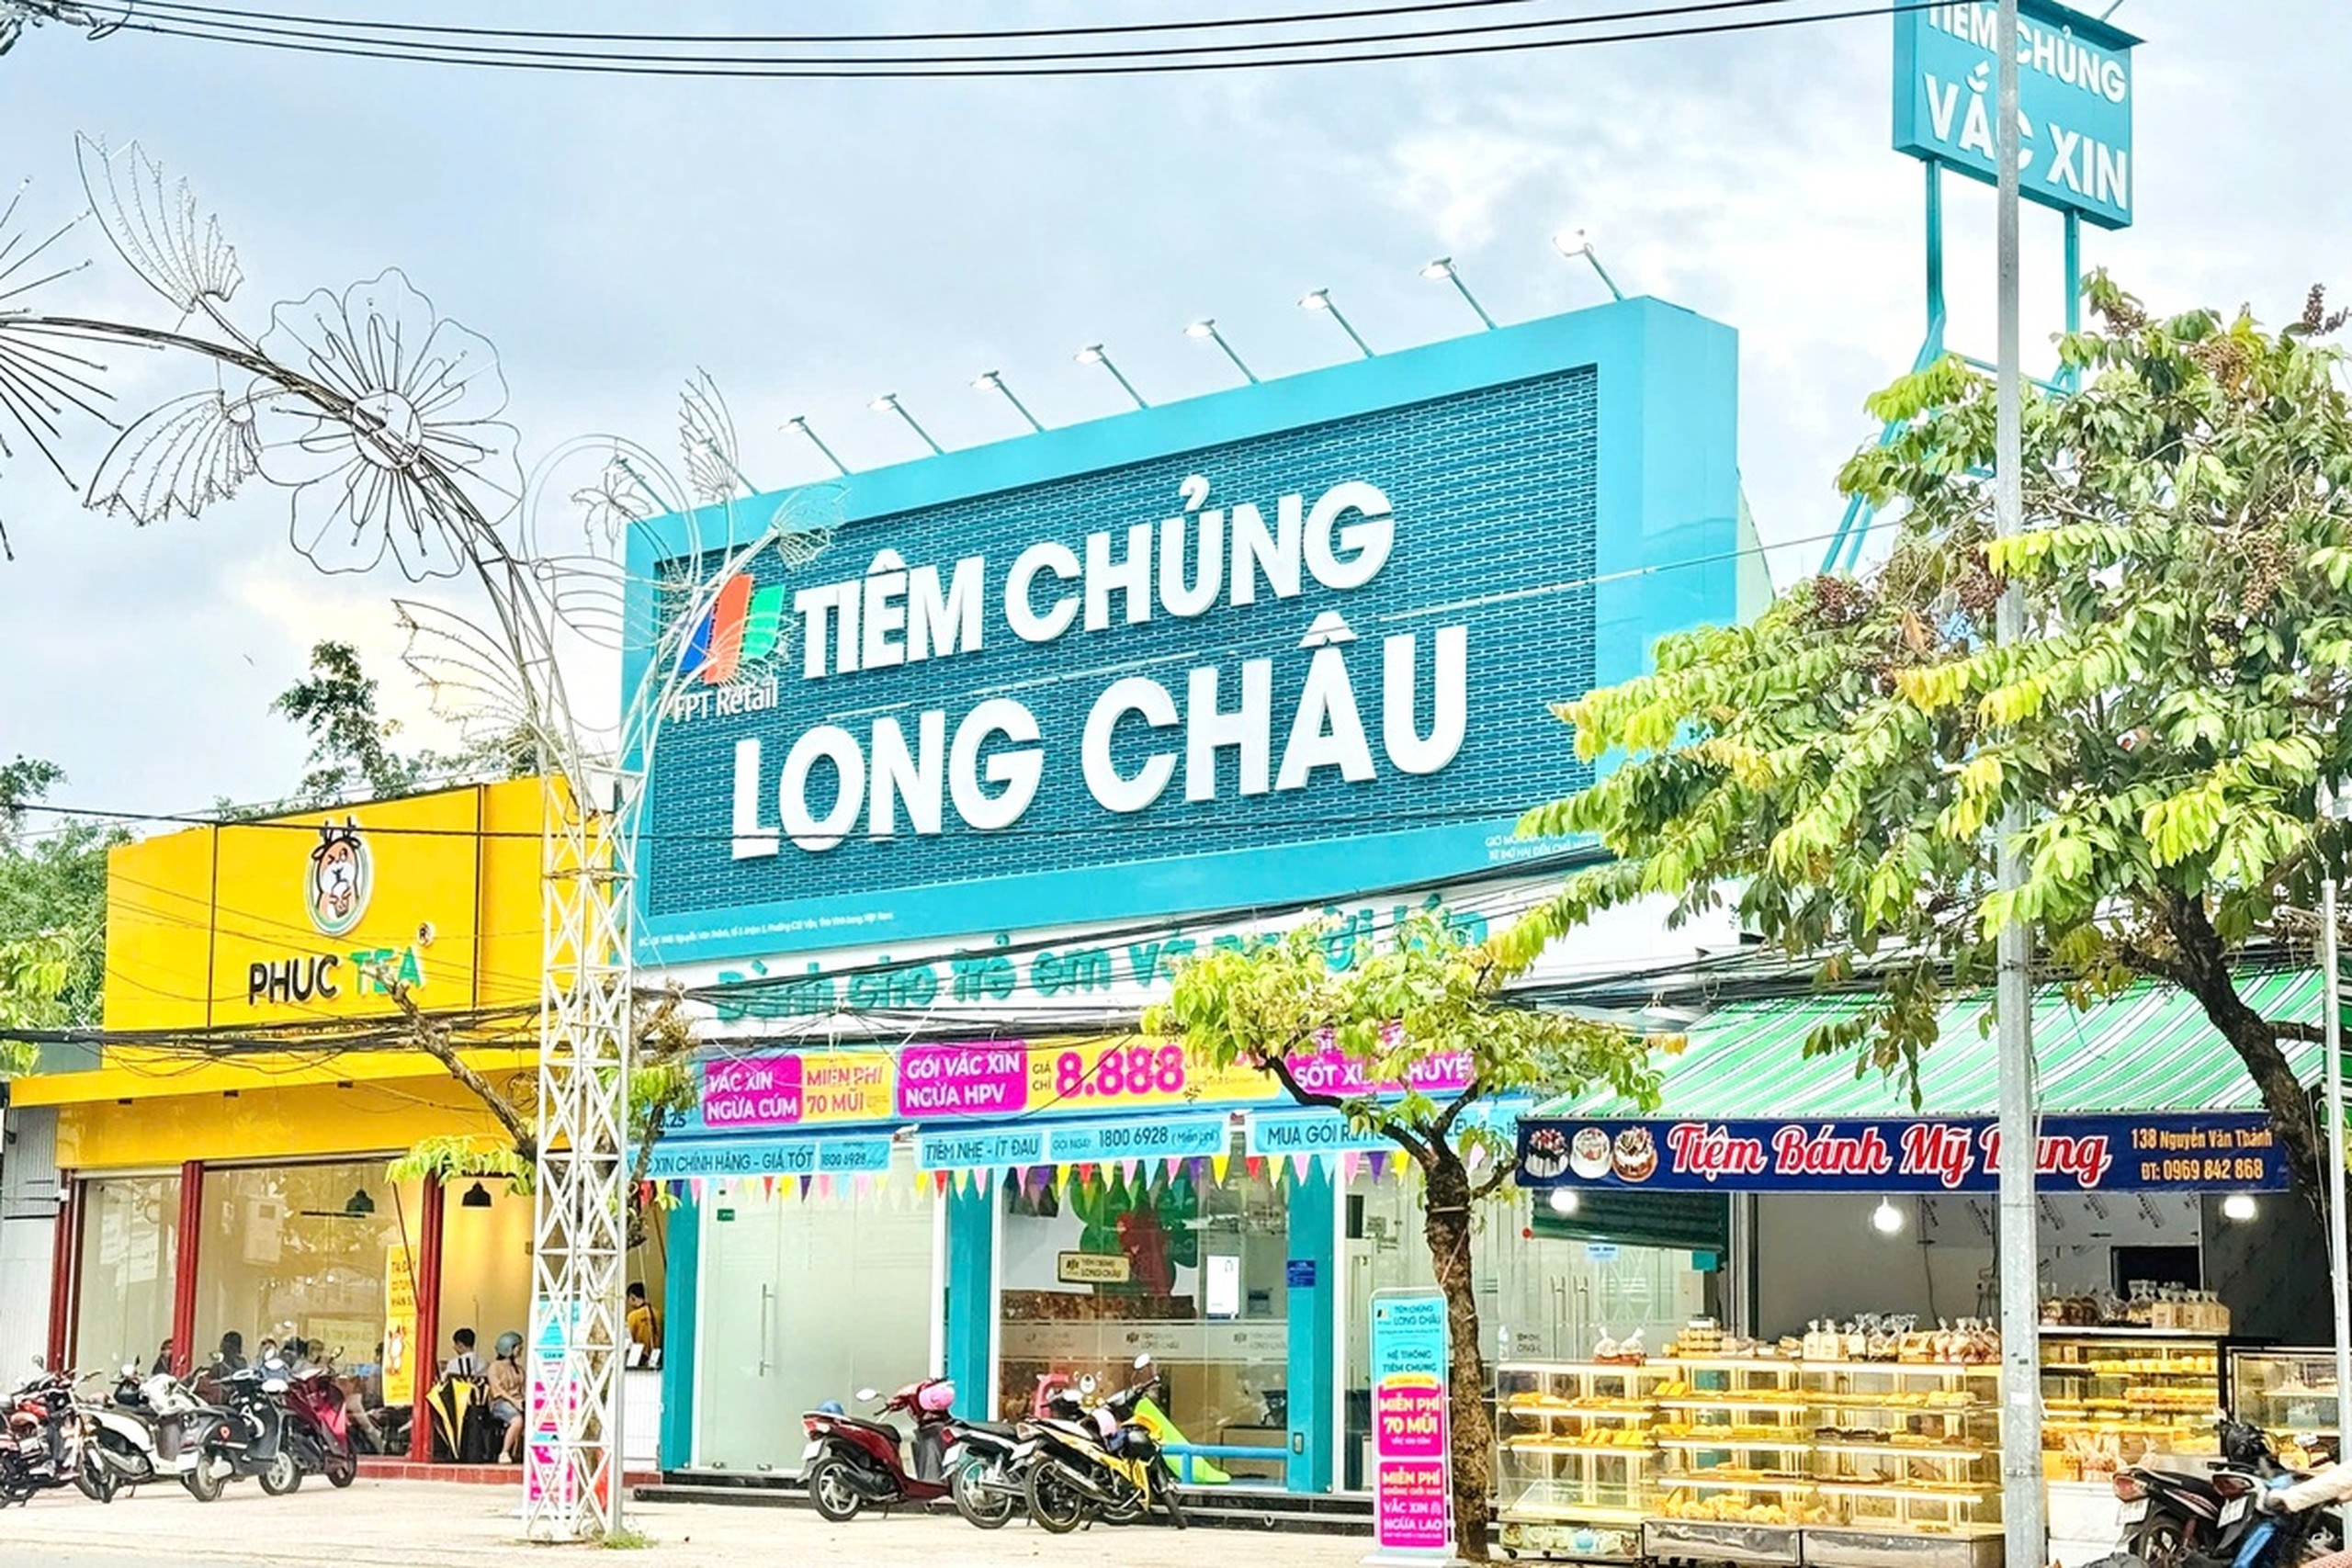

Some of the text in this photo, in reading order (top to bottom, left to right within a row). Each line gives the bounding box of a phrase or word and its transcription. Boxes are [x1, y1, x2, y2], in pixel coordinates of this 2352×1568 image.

[2046, 122, 2127, 210] XIN
[794, 475, 1395, 679] TIÊM CHỦNG
[674, 677, 778, 723] FPT Retail
[733, 611, 1468, 861] LONG CHÂU
[249, 946, 423, 1006] PHUC TEA
[717, 959, 835, 1022] Dành
[846, 955, 937, 1008] cho
[951, 933, 1017, 1000] trẻ
[1030, 947, 1111, 997] em
[807, 1059, 850, 1086] MIỄN
[907, 1050, 1021, 1079] GÓI VẮC XIN
[1033, 1060, 1052, 1077] GIÁ
[1057, 1045, 1185, 1099] 8.888
[1295, 1056, 1338, 1087] SỐT
[707, 1066, 774, 1093] VẮC XIN
[1033, 1077, 1052, 1091] CHỈ
[707, 1094, 797, 1121] NGỪA CÚM
[807, 1095, 827, 1113] 70
[831, 1088, 864, 1112] MŨI
[905, 1083, 964, 1108] NGỪA
[967, 1084, 1006, 1105] HPV
[1098, 1130, 1130, 1147] 1800
[1133, 1127, 1169, 1145] 6928
[1268, 1125, 1302, 1145] MUA
[1306, 1120, 1338, 1143] GÓI
[2132, 1128, 2157, 1149] 138
[2159, 1126, 2206, 1151] Nguyễn
[2208, 1128, 2233, 1147] Văn
[654, 1157, 674, 1172] XIN
[675, 1152, 714, 1173] CHÍNH
[763, 1149, 785, 1169] GIÁ
[788, 1145, 814, 1169] TỐT
[925, 1140, 955, 1162] TIÊM
[956, 1139, 983, 1164] NHẸ
[994, 1136, 1010, 1157] ÍT
[1012, 1136, 1040, 1156] ĐAU
[1668, 1122, 1769, 1182] Tiệm
[1771, 1122, 1893, 1175] Bánh
[1899, 1122, 1974, 1188] Mỹ
[2141, 1157, 2264, 1181] ĐT: 0969 842 868
[1379, 1392, 1440, 1412] MIỄN PHÍ
[1383, 1412, 1438, 1434] 70 MŨI
[1382, 1466, 1441, 1484] MIỄN PHÍ
[1383, 1497, 1429, 1514] VẮC XIN
[1418, 1518, 1442, 1531] LAO
